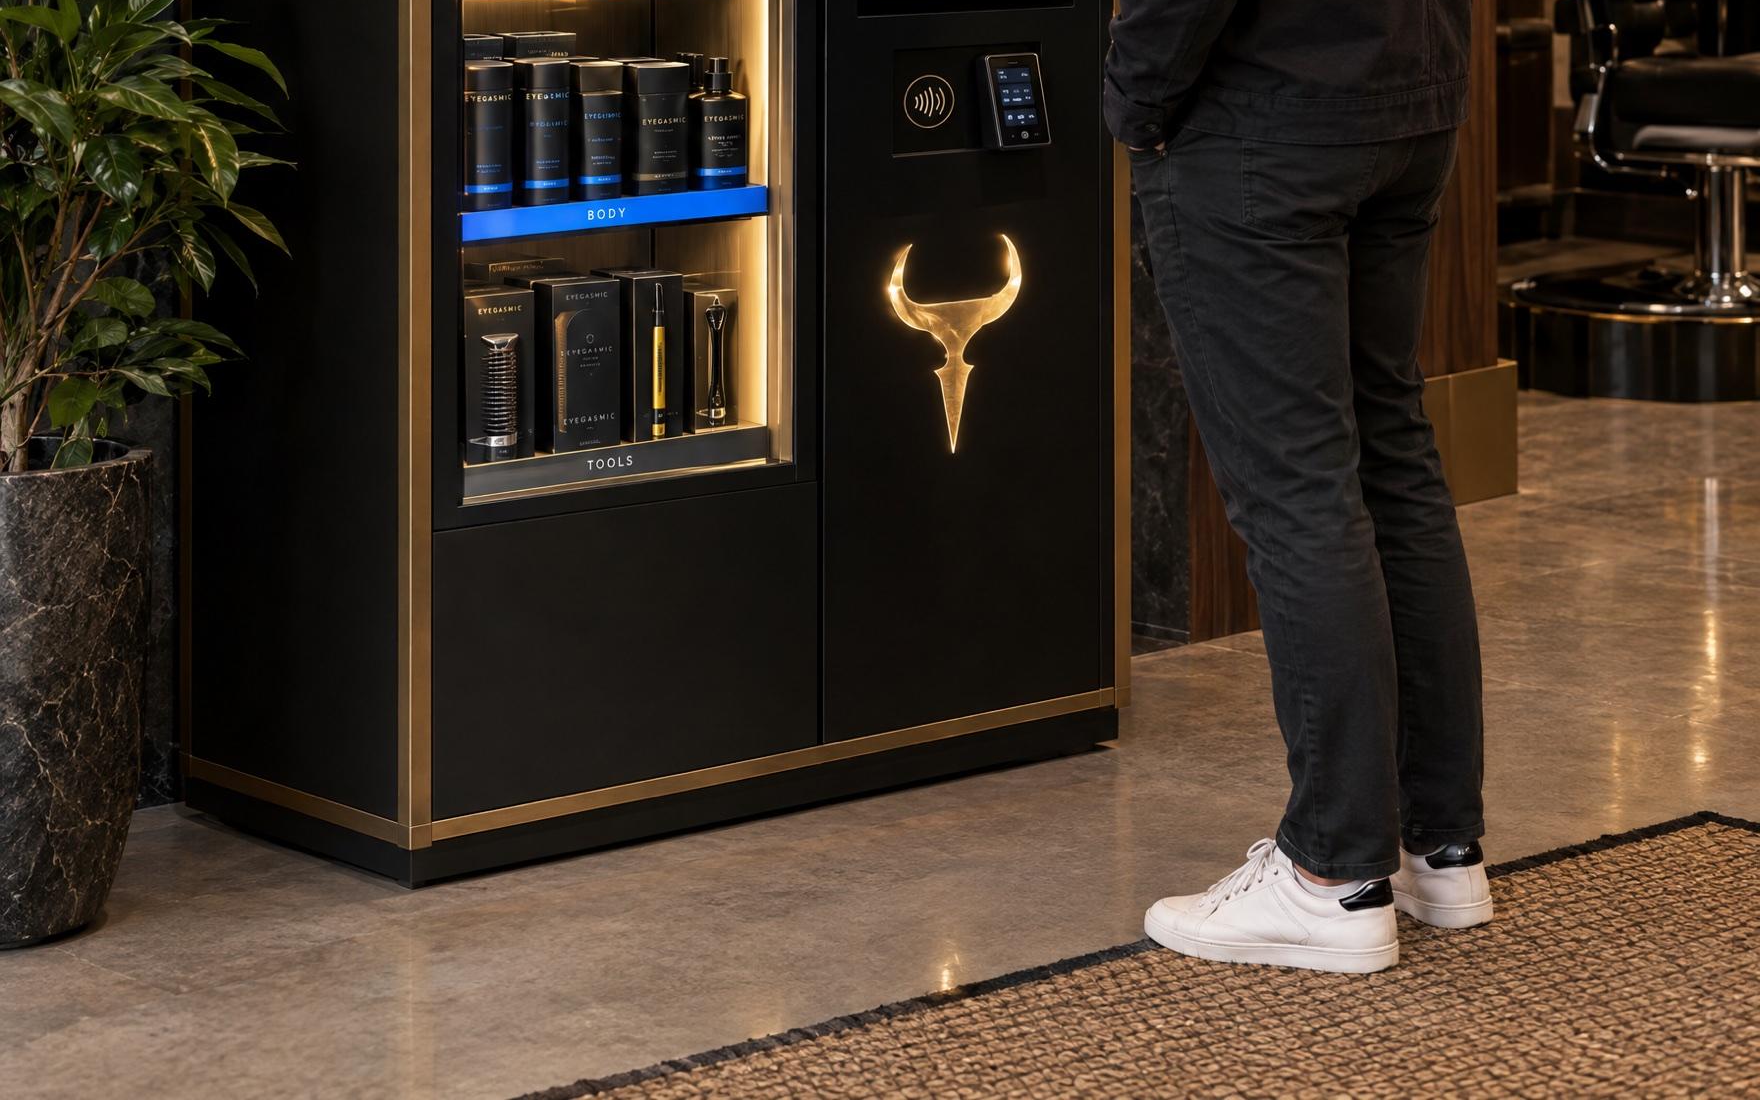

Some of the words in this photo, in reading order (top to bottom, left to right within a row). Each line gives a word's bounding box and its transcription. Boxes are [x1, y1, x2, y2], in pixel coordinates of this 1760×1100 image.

[642, 116, 687, 126] EYEGASMIC
[587, 207, 626, 221] BODY
[565, 291, 608, 301] EYEGASMIC
[478, 305, 522, 315] EYEGASMIC
[563, 412, 616, 426] EYEGASMIC
[587, 455, 633, 471] TOOLS
